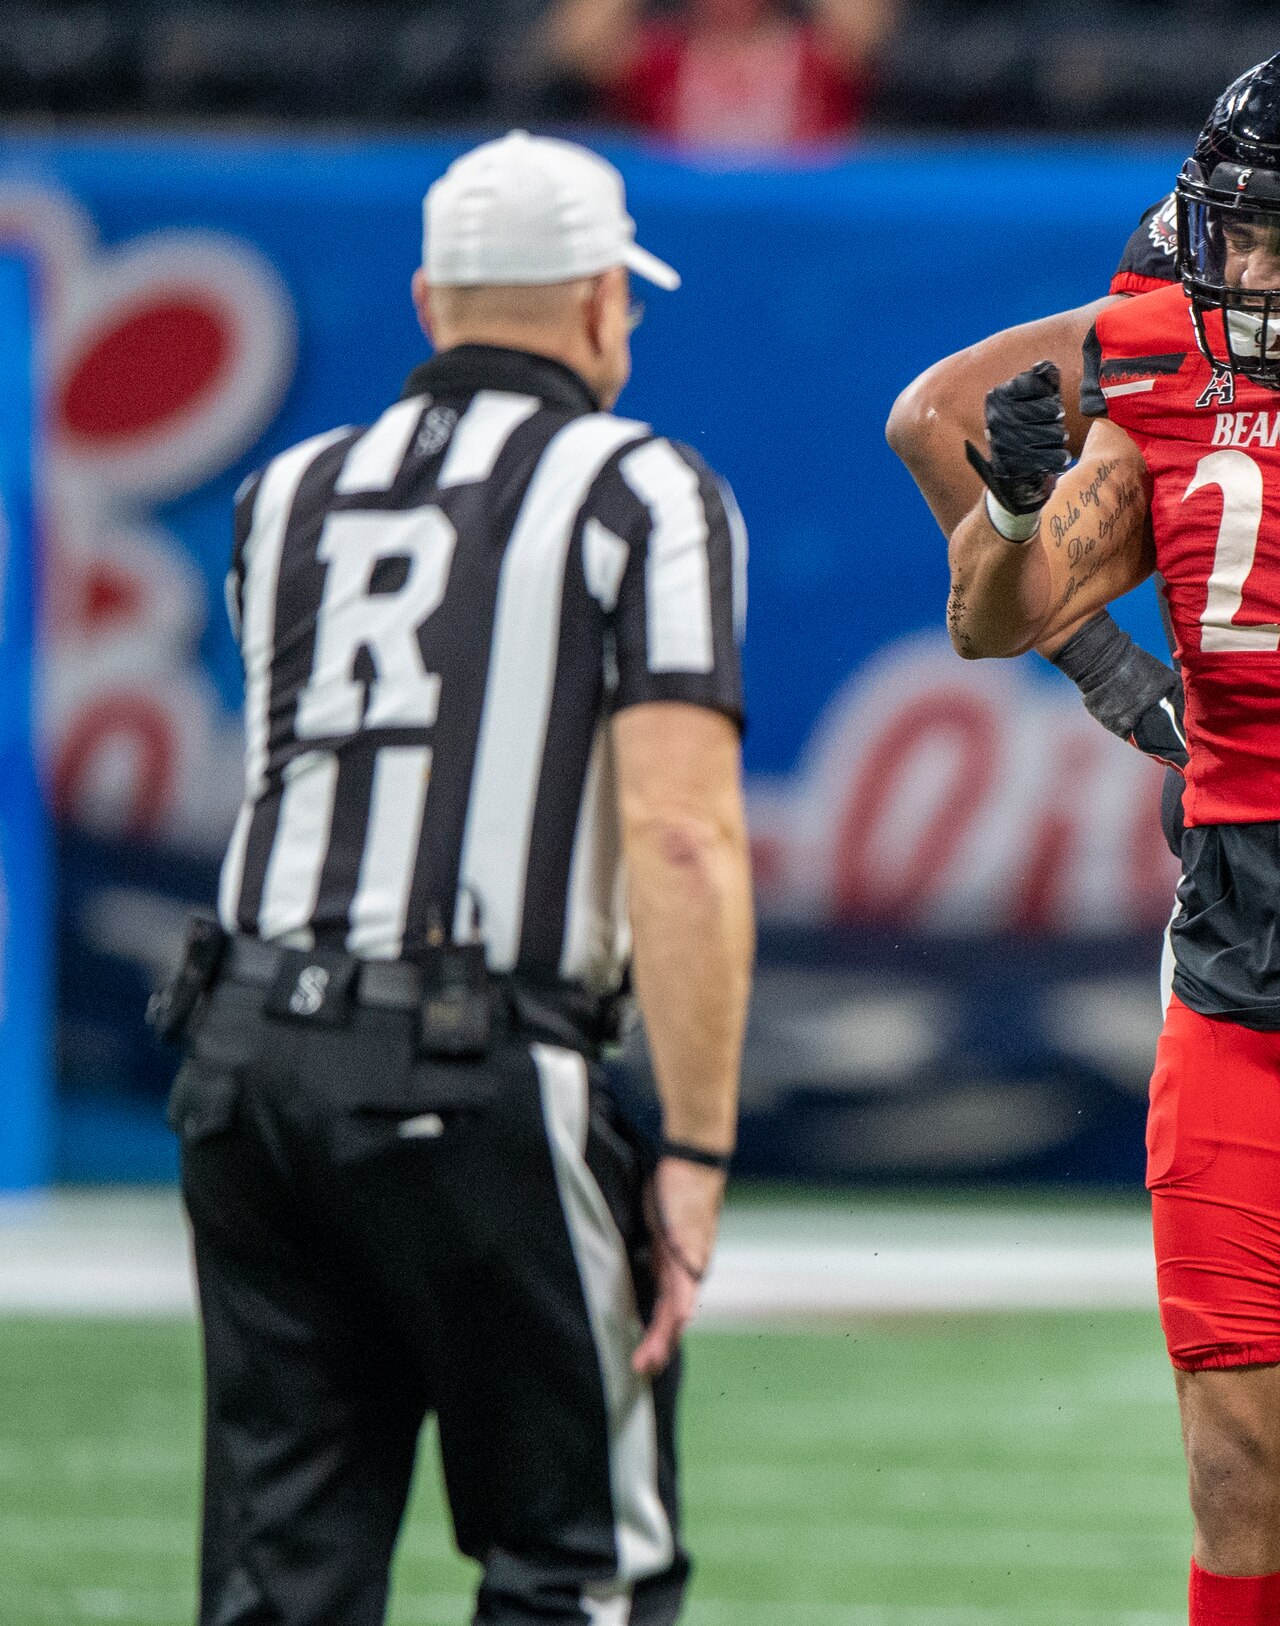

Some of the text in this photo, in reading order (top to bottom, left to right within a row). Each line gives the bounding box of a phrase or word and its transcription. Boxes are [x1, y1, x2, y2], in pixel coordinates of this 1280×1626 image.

[1051, 501, 1081, 548] Ride
[1079, 458, 1121, 506] together
[1067, 536, 1097, 569] Die
[295, 504, 457, 740] R
